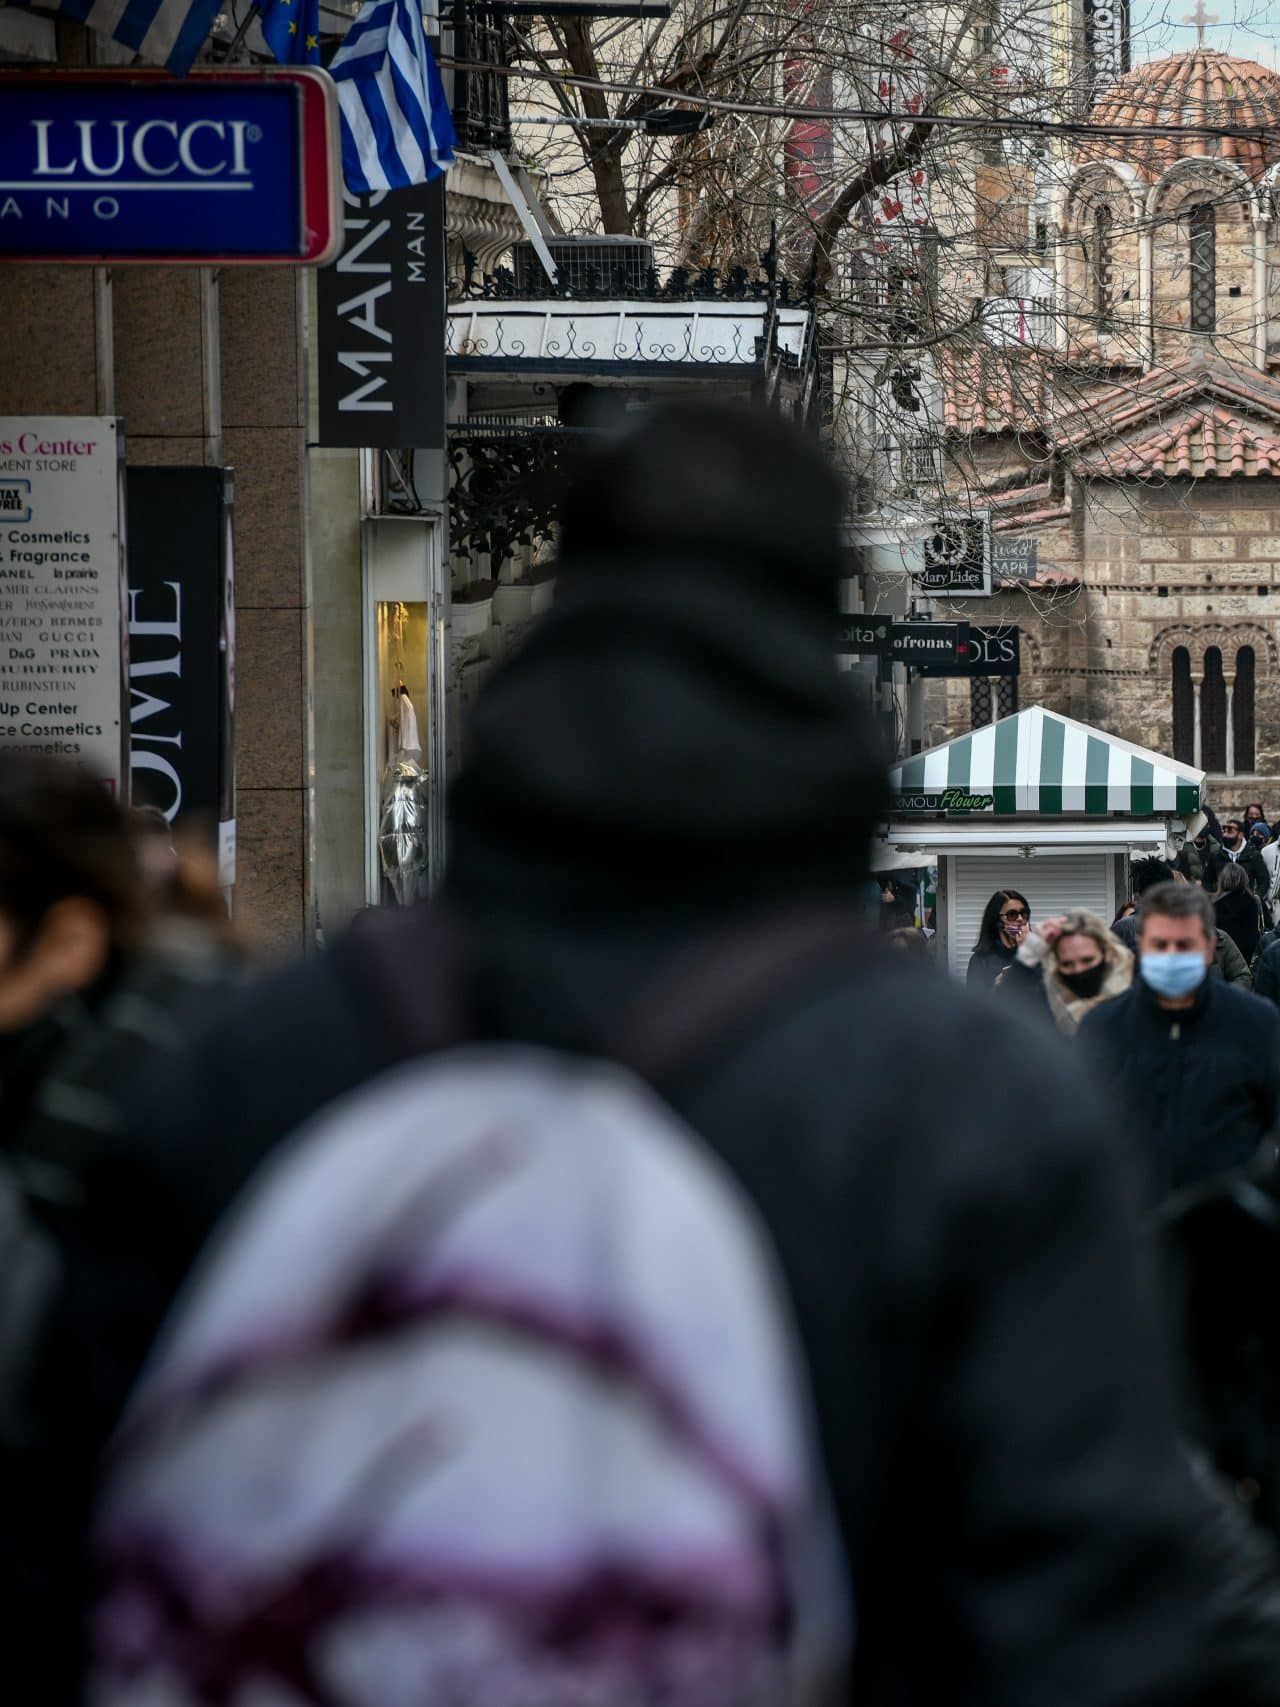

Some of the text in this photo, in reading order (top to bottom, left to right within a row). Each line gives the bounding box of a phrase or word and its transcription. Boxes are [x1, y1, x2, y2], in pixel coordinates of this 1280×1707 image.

[407, 212, 426, 282] MAN
[18, 432, 97, 456] Center
[36, 460, 77, 472] STORE
[0, 500, 22, 510] REE
[8, 530, 91, 543] Cosmetics
[10, 550, 90, 565] Fragrance
[920, 573, 949, 584] Mary
[39, 632, 95, 642] GUCCI
[50, 648, 100, 658] PRADA
[26, 702, 78, 715] Center
[21, 723, 102, 736] Cosmetics
[940, 790, 991, 808] Flower
